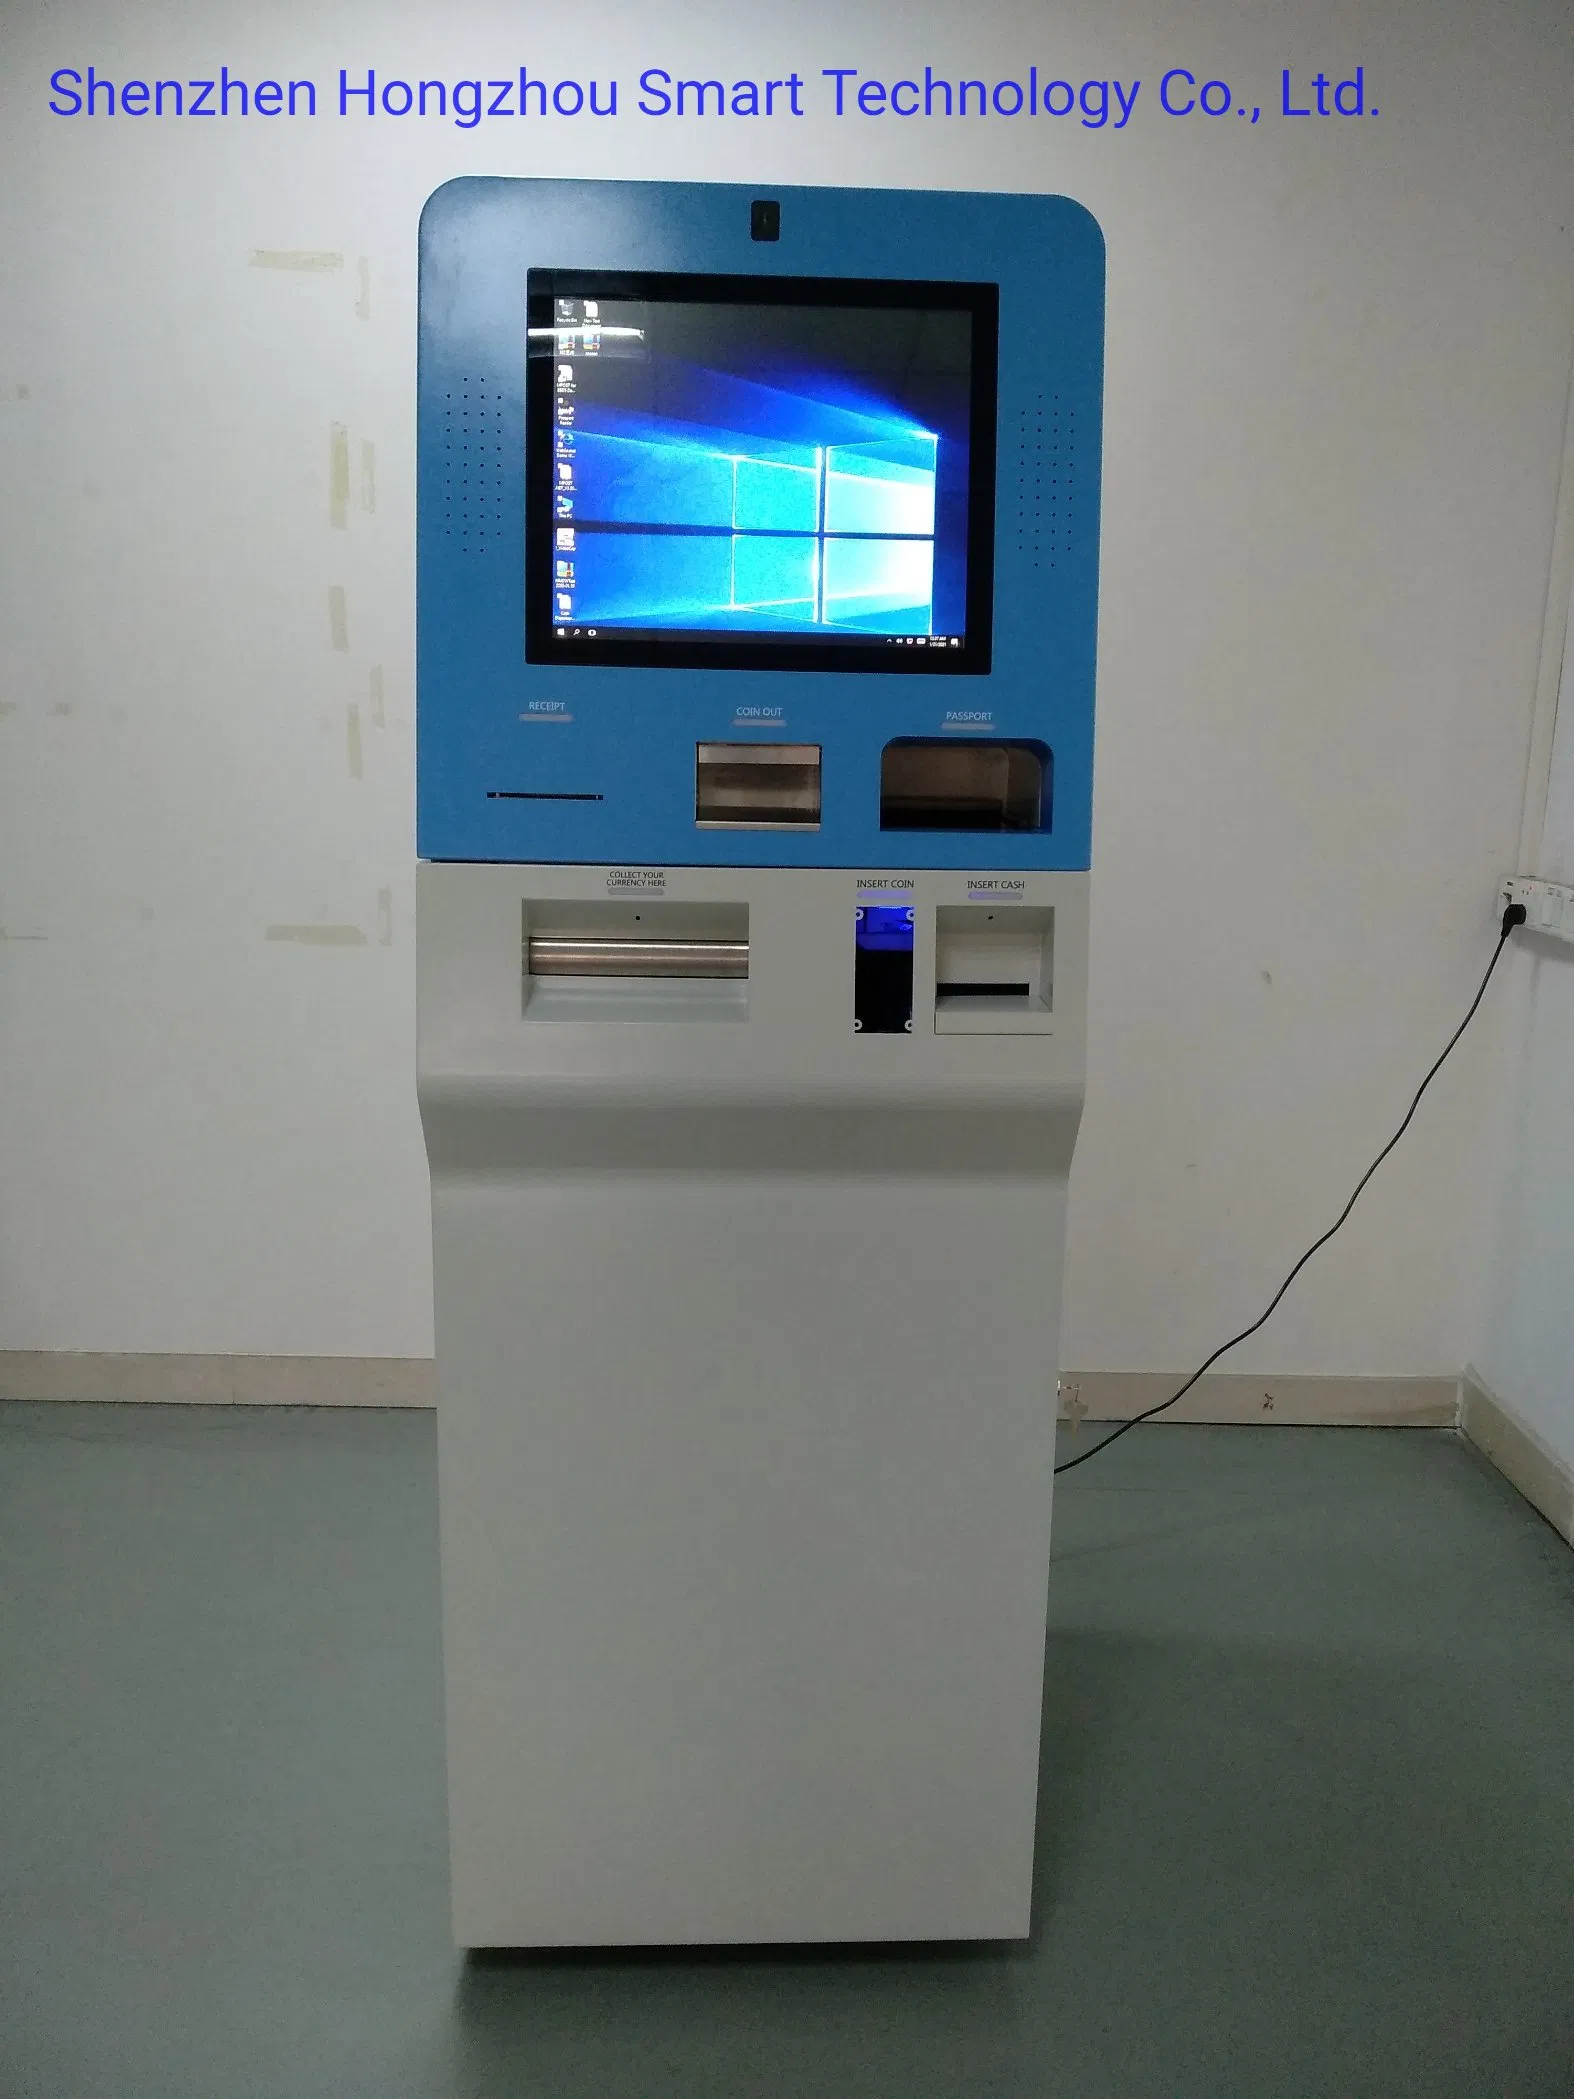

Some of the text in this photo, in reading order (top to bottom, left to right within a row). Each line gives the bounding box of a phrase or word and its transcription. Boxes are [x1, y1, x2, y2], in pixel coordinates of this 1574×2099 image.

[528, 701, 566, 711] RECEIPT
[736, 706, 784, 716] COIN OUT
[946, 711, 993, 721] PASSPORT
[609, 871, 664, 879] COLLECT YOUR
[606, 879, 667, 887] CURRENCY HERE
[856, 879, 915, 888] INSERT COIN
[967, 880, 1025, 889] INSERT CASH
